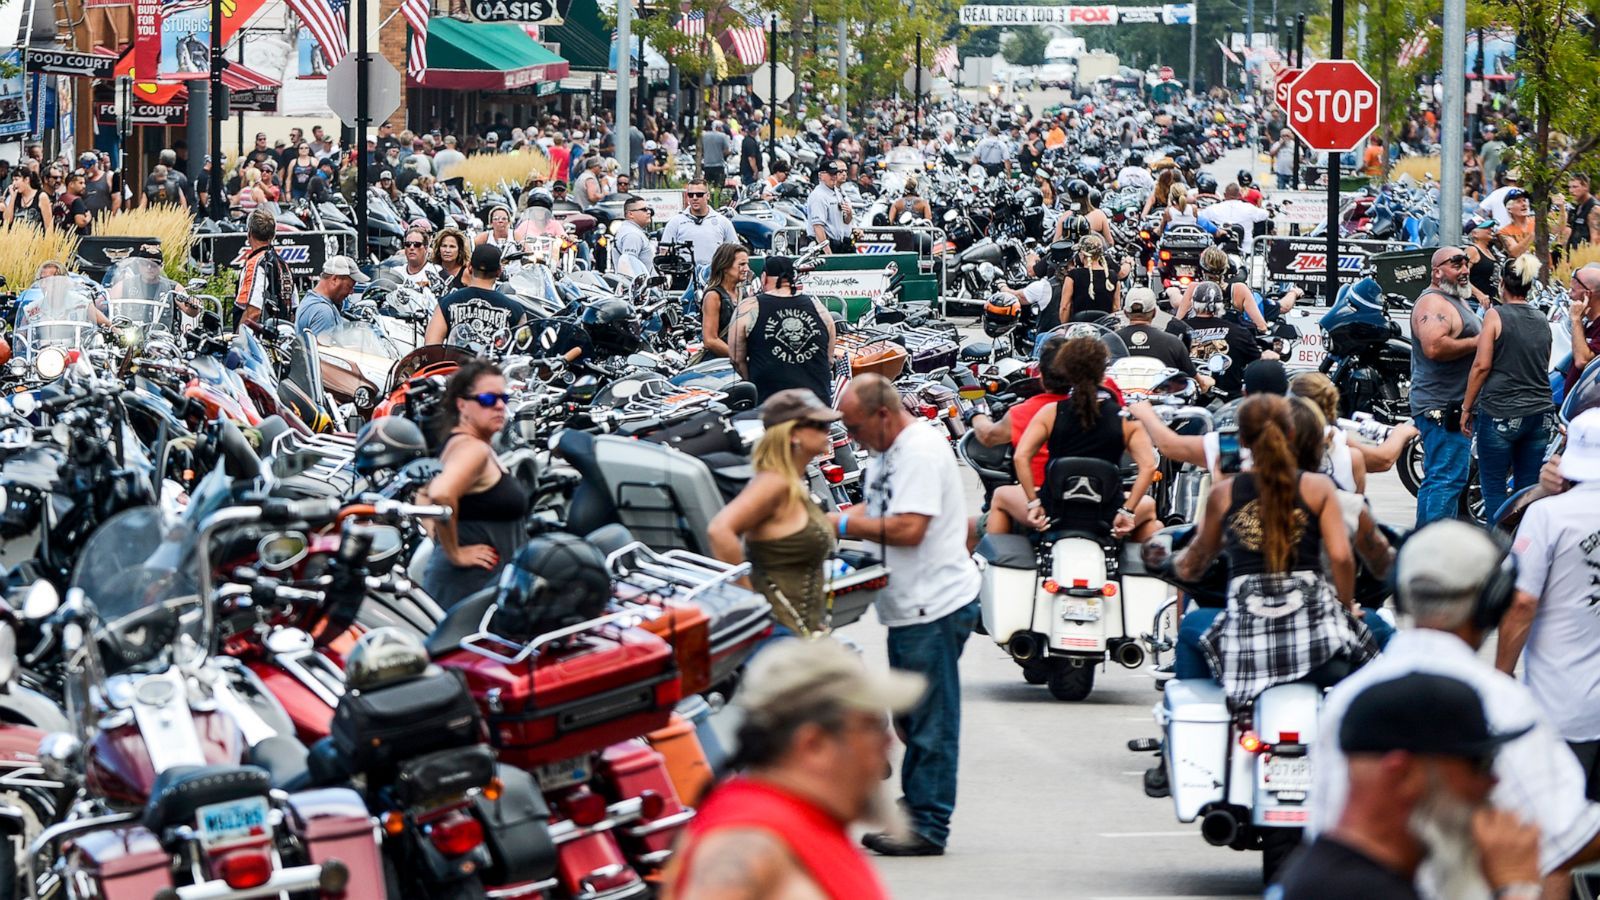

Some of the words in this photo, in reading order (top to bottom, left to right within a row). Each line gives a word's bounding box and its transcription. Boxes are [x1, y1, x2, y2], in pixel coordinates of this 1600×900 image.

[137, 5, 161, 15] BUD'S
[476, 1, 543, 20] OASIS
[963, 8, 992, 21] REAL
[997, 8, 1028, 21] ROCK
[1032, 8, 1065, 23] 100.3
[1070, 9, 1110, 22] FOX
[137, 15, 155, 25] FOR
[163, 18, 209, 32] STURGIS
[137, 26, 158, 35] YOU.
[27, 52, 63, 65] FOOD
[66, 56, 112, 69] COURT
[100, 105, 136, 115] FOD
[138, 106, 182, 116] COURT
[1294, 89, 1374, 123] STOP
[282, 238, 295, 246] OIL
[1289, 243, 1306, 251] THE
[1286, 252, 1365, 273] AMOIL
[1273, 272, 1304, 281] STURGIS
[764, 317, 779, 340] THE
[777, 308, 821, 336] KNUCKLE
[772, 343, 820, 365] SALOON
